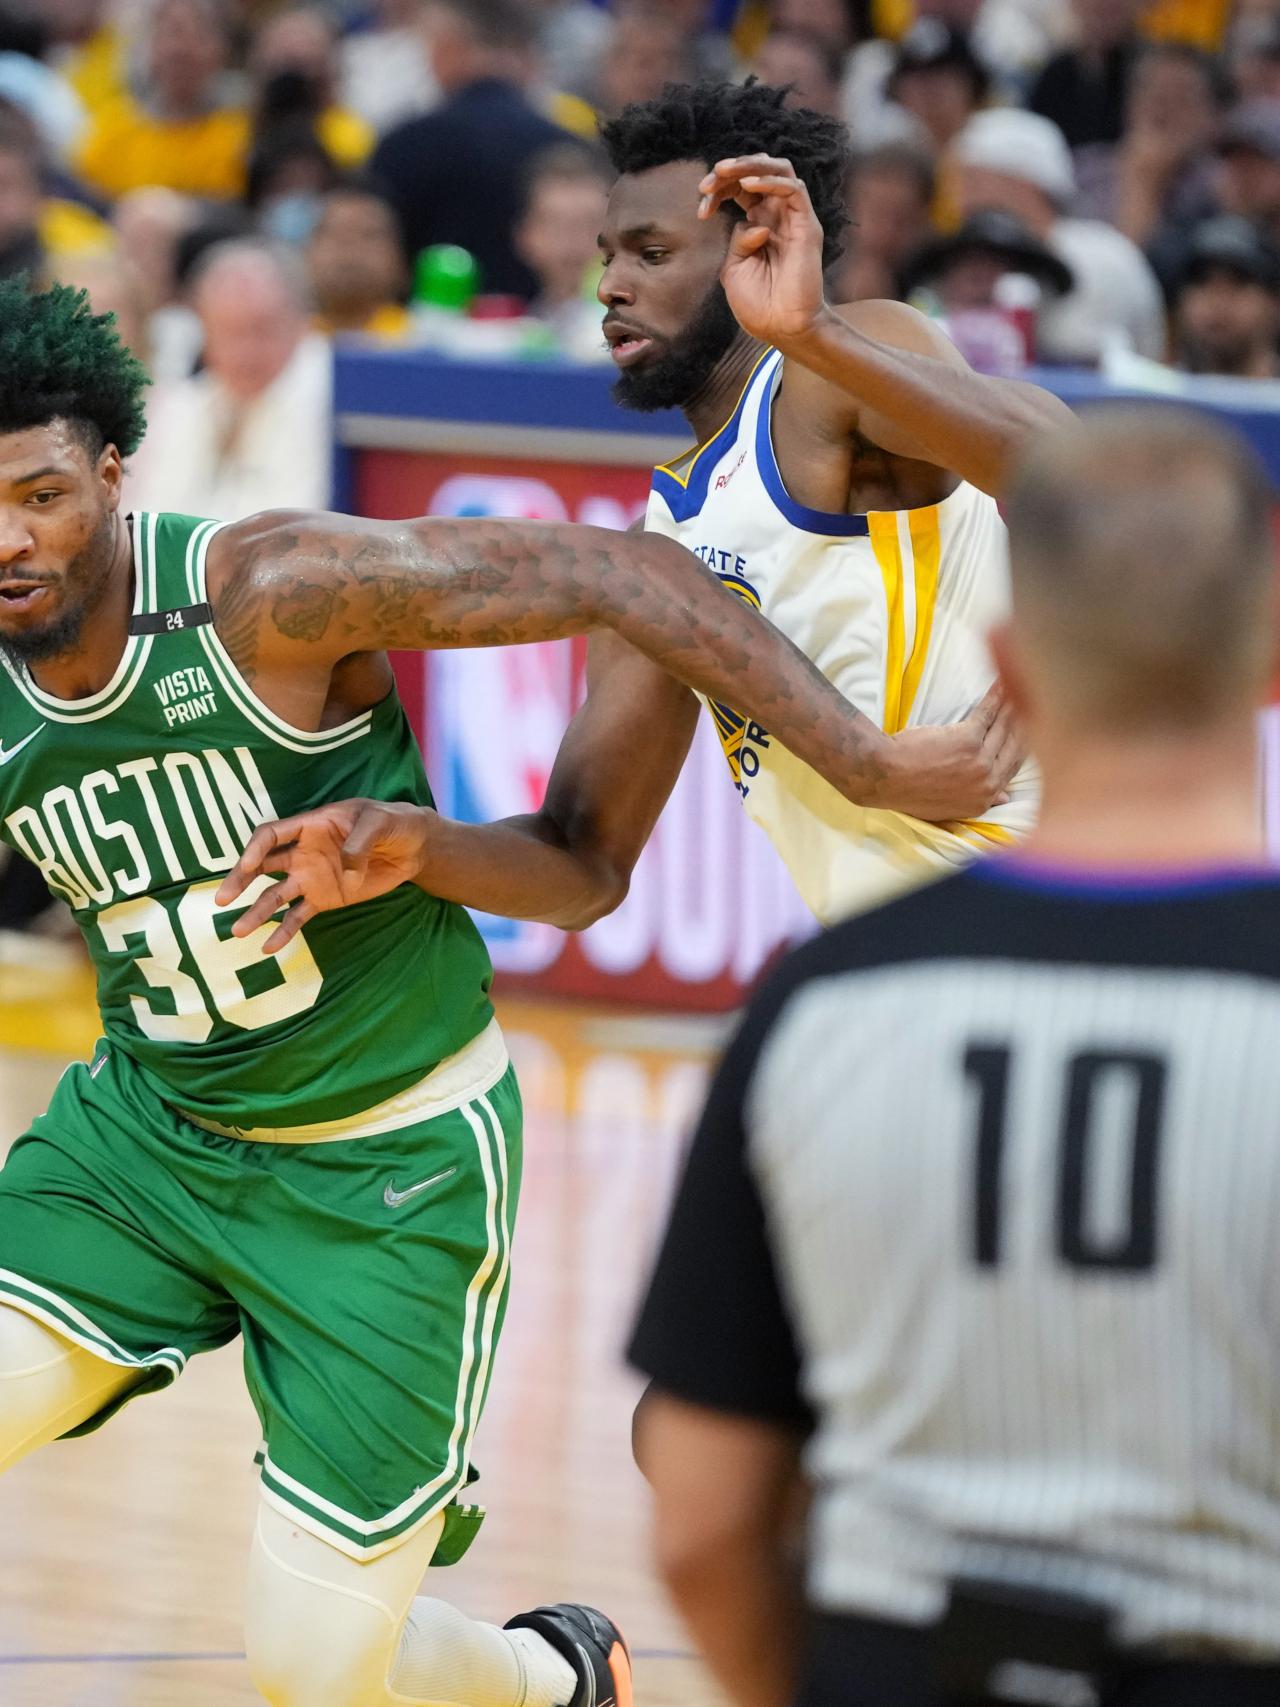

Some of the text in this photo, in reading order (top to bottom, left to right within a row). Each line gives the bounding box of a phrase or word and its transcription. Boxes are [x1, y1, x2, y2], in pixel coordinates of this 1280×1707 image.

[166, 610, 185, 631] 24
[153, 666, 214, 706] VISTA
[163, 692, 218, 727] PRINT
[5, 746, 280, 911] BOSTON
[96, 873, 324, 1044] 36
[962, 1037, 1172, 1274] 10
